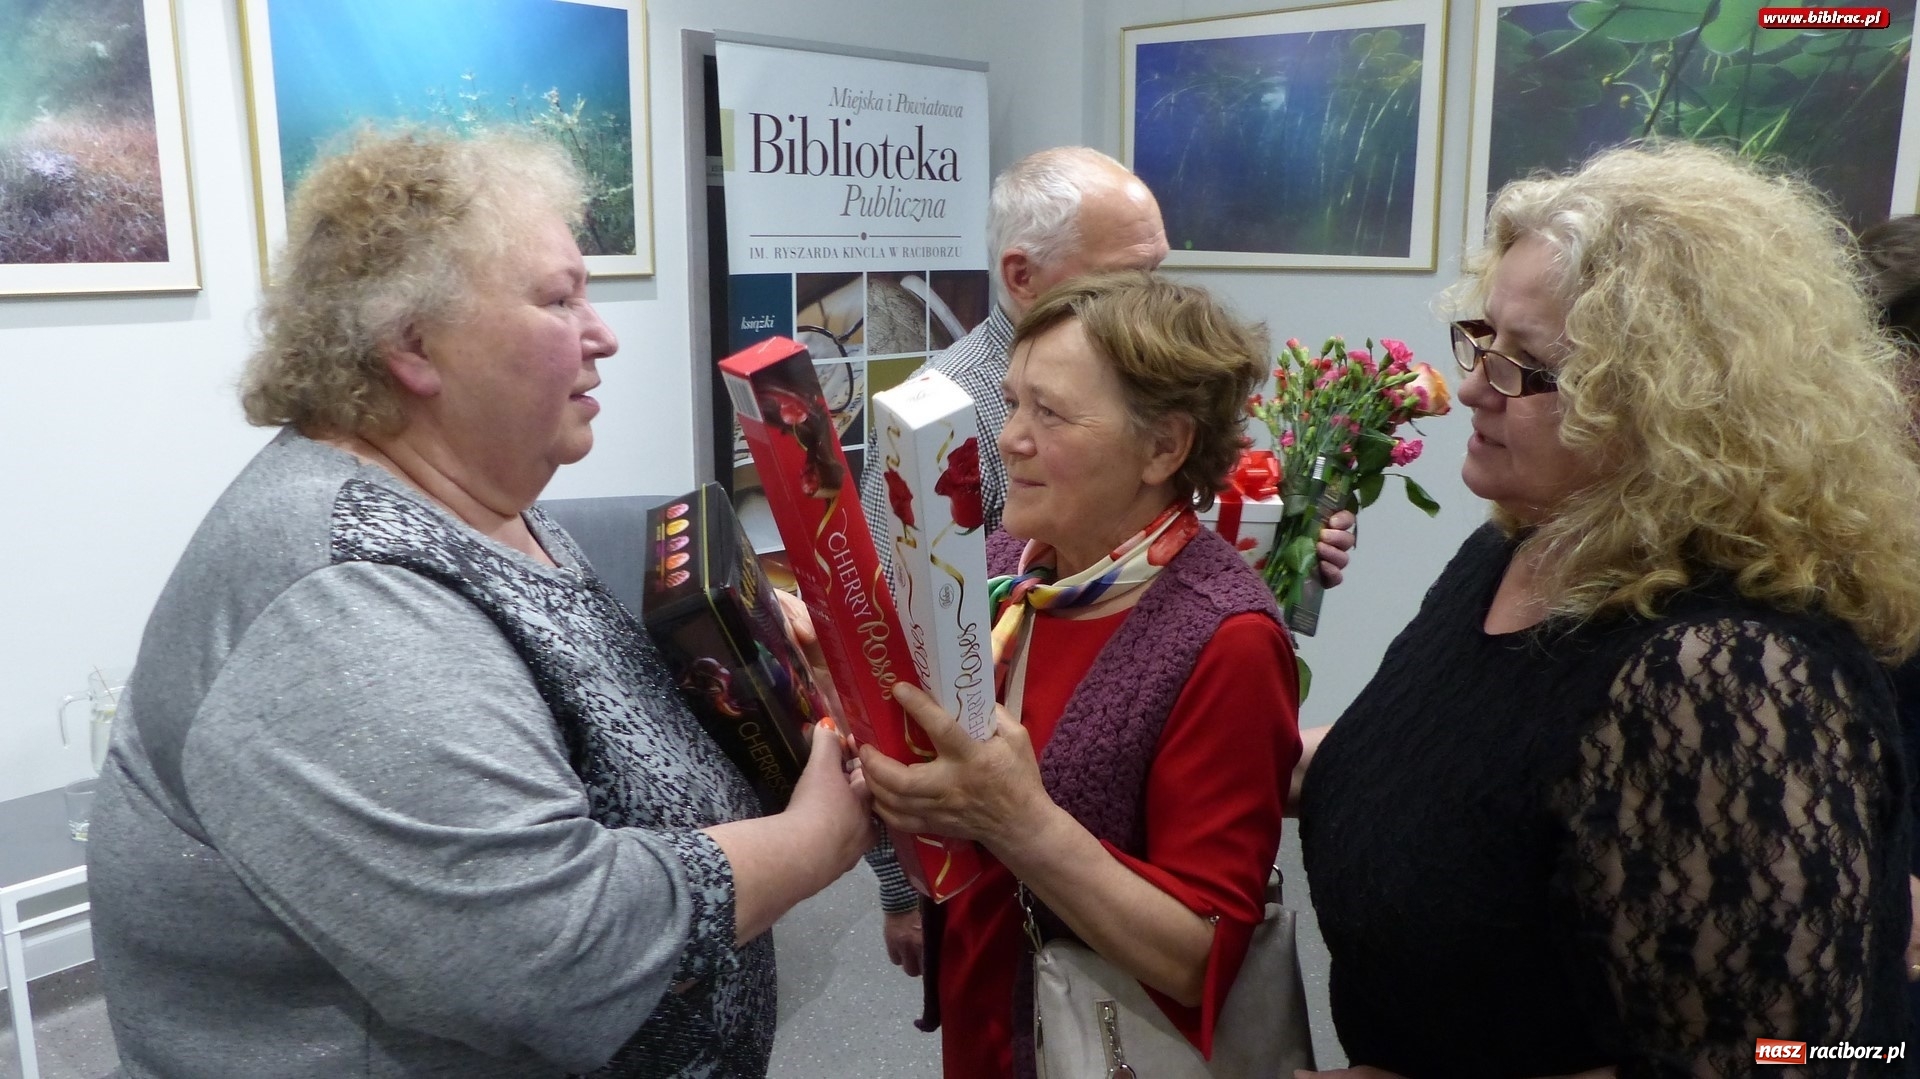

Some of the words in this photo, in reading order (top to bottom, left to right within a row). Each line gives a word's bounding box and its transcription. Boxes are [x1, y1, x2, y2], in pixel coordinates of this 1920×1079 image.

[829, 86, 883, 116] Miejska
[886, 93, 892, 112] i
[895, 93, 963, 118] Powiatowa
[748, 112, 962, 182] Biblioteka
[840, 184, 946, 222] Publiczna
[750, 247, 768, 259] IM.
[774, 247, 839, 259] RYSZARDA
[843, 247, 885, 259] KINCLA
[889, 247, 898, 259] W
[902, 246, 962, 258] RACIBORZU
[741, 315, 775, 333] książki
[828, 508, 872, 619] CHERRY
[857, 621, 897, 700] Roses
[954, 622, 983, 690] Roses
[967, 690, 986, 743] HERRY
